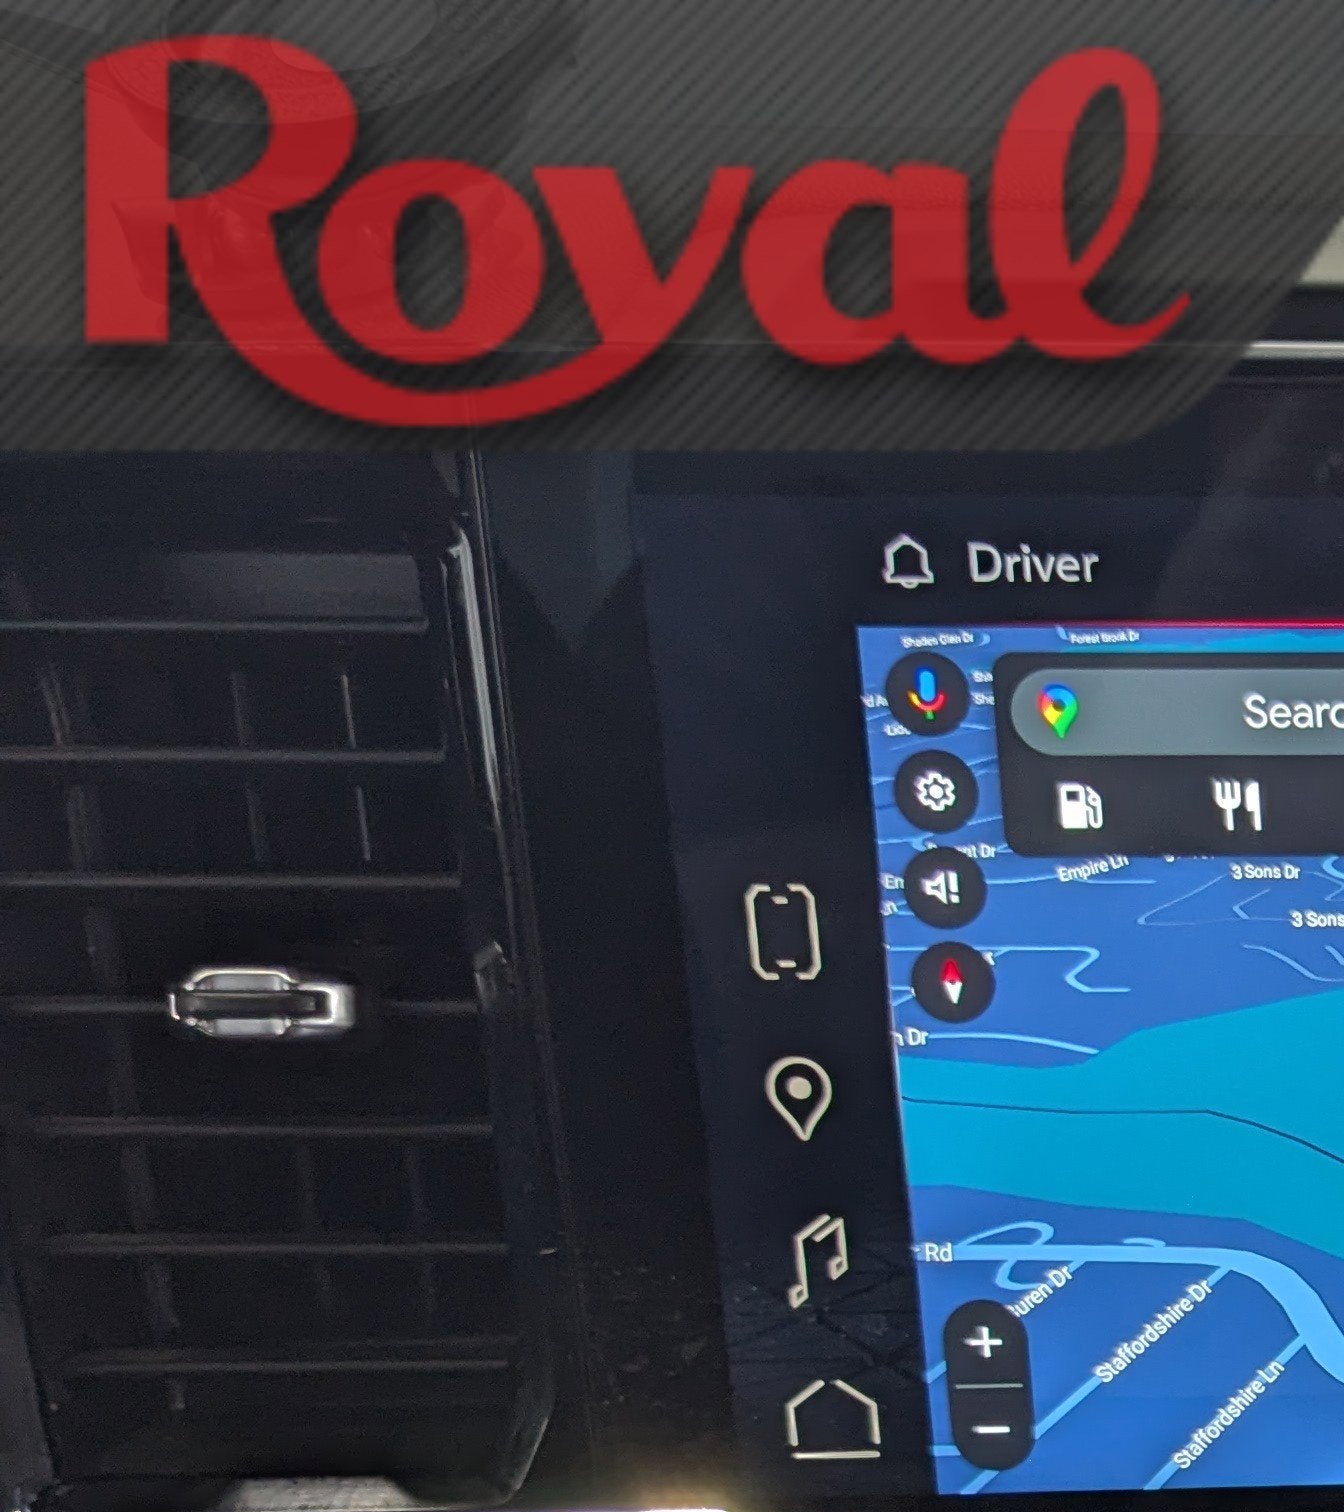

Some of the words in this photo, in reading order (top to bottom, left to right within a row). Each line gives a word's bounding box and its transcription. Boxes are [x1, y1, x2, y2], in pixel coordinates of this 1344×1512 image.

[968, 542, 1099, 584] Driver
[978, 845, 996, 858] Dr
[1058, 859, 1109, 882] Empire
[1231, 865, 1242, 880] 3
[1243, 864, 1279, 880] Sons
[1282, 865, 1301, 880] Dr
[1290, 910, 1304, 928] 3
[908, 1028, 928, 1046] Dr
[925, 1242, 953, 1263] Rd
[1048, 1264, 1074, 1291] Dr
[1094, 1292, 1195, 1385] Staffordshire
[1186, 1277, 1213, 1303] Dr
[1173, 1376, 1271, 1469] Staffordshire
[1263, 1360, 1285, 1385] Ln
